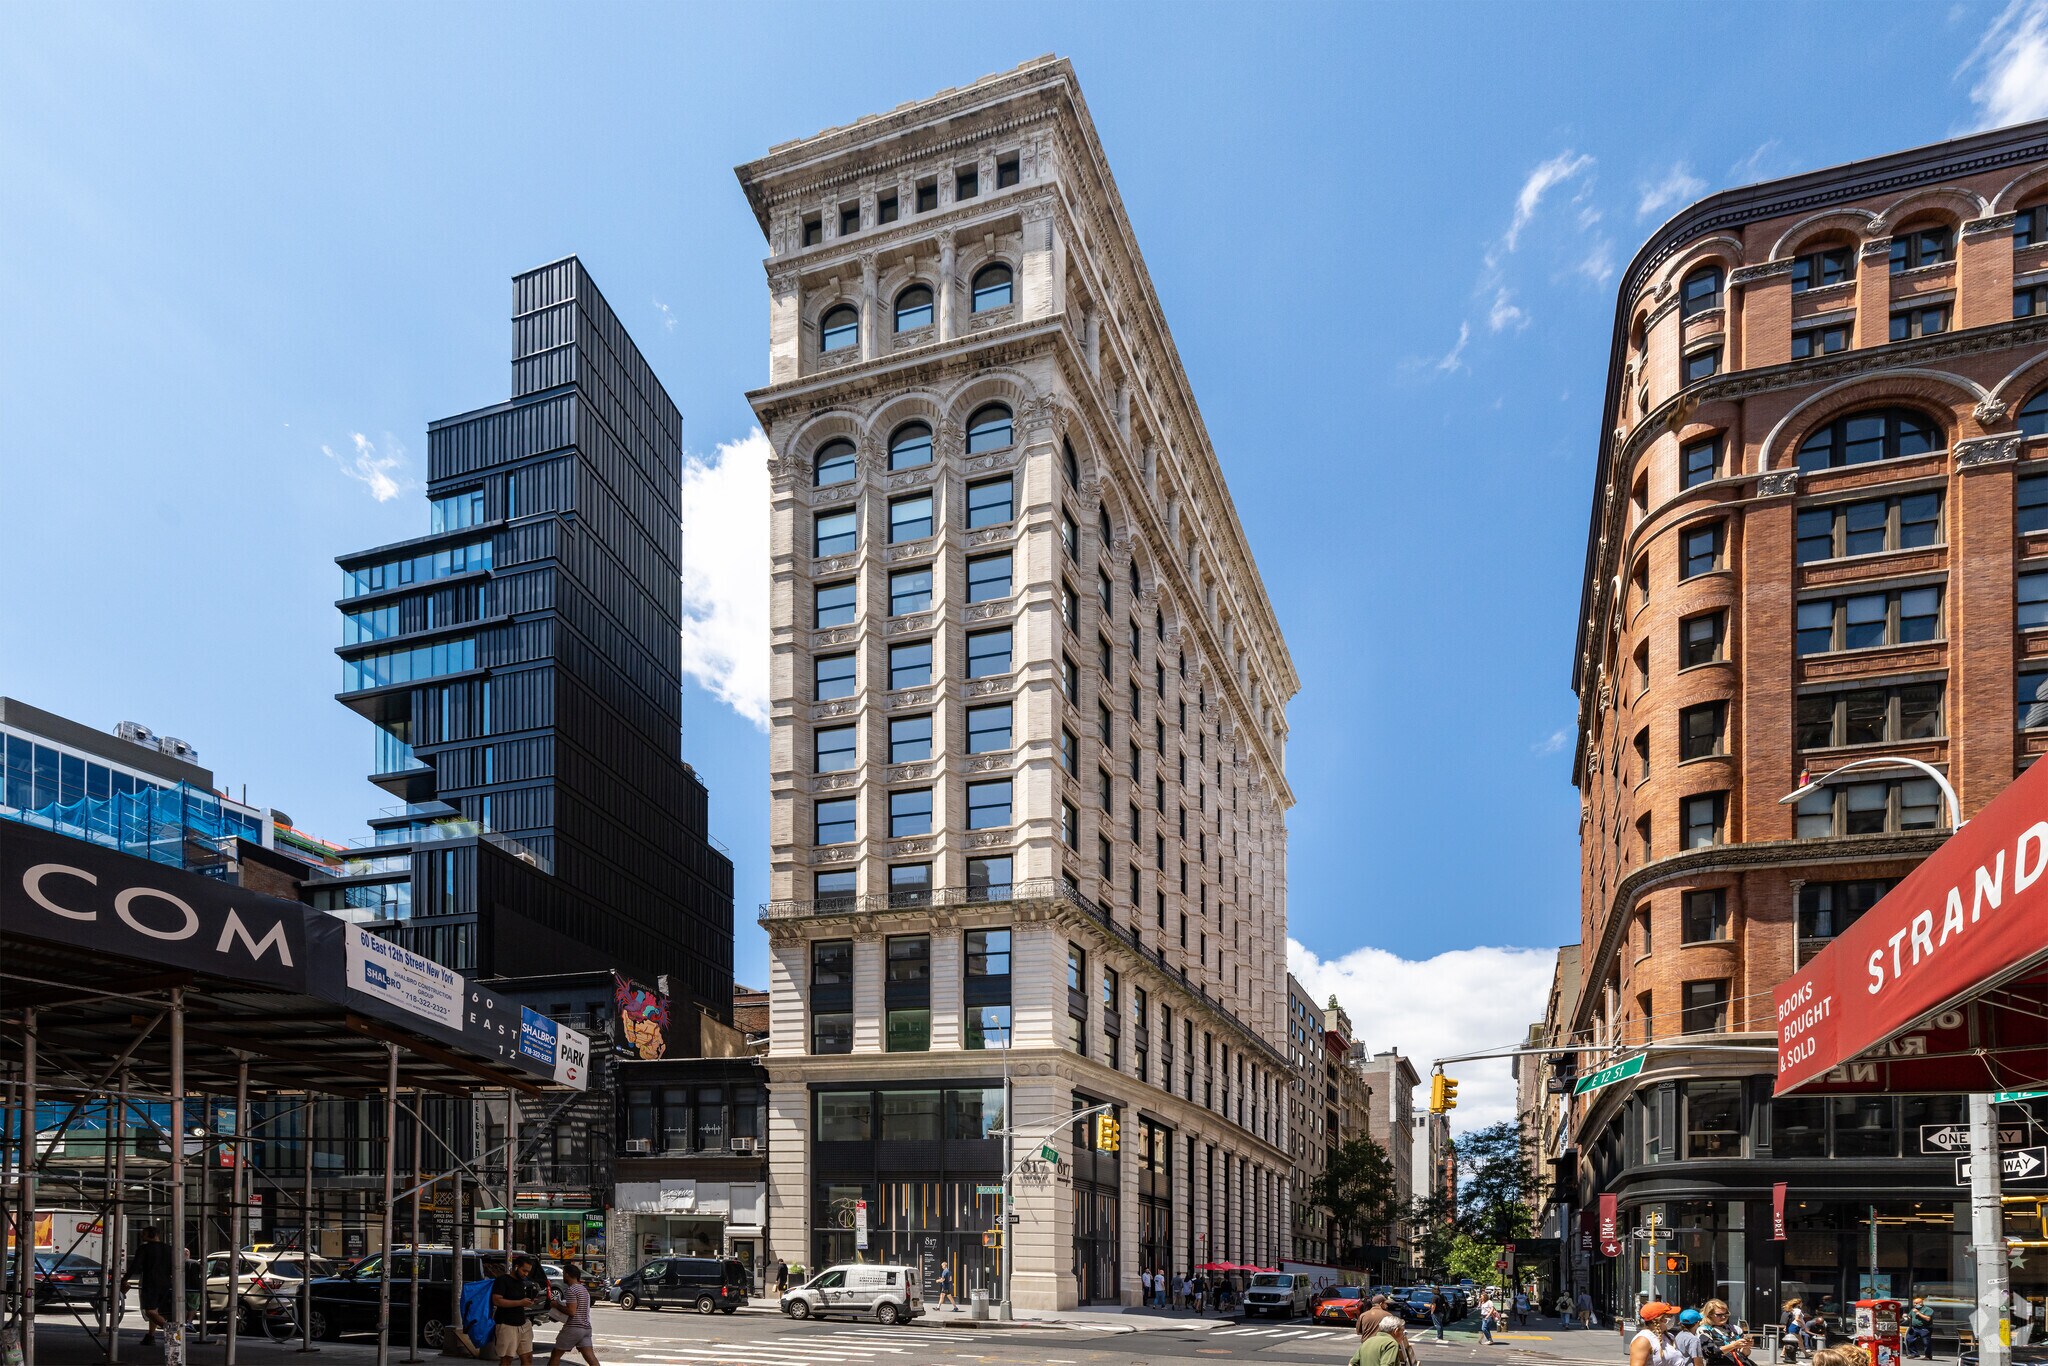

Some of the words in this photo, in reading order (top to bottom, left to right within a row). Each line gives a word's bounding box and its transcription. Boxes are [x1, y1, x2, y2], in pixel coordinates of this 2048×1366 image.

[23, 863, 294, 968] COM
[1868, 821, 2048, 994] STRAND
[360, 931, 370, 948] 60
[371, 937, 387, 956] East
[388, 945, 404, 963] 12th
[405, 952, 425, 972] Street
[426, 961, 440, 979] New
[441, 968, 454, 986] York
[366, 967, 402, 990] SHALBRO
[393, 971, 418, 986] SHALBRO
[417, 981, 453, 1001] CONSTRUCTION
[405, 992, 448, 1015] 718-322-2323
[417, 989, 435, 1000] GROUP
[472, 993, 493, 1009] 60
[1779, 981, 1812, 1022] BOOKS
[470, 1012, 517, 1040] EAST
[1784, 996, 1832, 1044] BOUGHT
[522, 1023, 556, 1045] SHALBRO
[499, 1045, 516, 1059] 12
[561, 1044, 585, 1068] PARK
[1780, 1056, 1786, 1073] &
[1787, 1037, 1816, 1068] SOLD
[1592, 1075, 1599, 1087] E
[1601, 1070, 1611, 1083] 12
[1613, 1065, 1624, 1079] St
[1938, 1133, 1968, 1144] ONE
[1057, 1158, 1070, 1187] 817
[2004, 1158, 2031, 1171] WAY
[1602, 1223, 1614, 1239] PRET
[1775, 1219, 1785, 1237] PRET
[925, 1237, 937, 1250] 817
[1582, 1235, 1592, 1248] PRET
